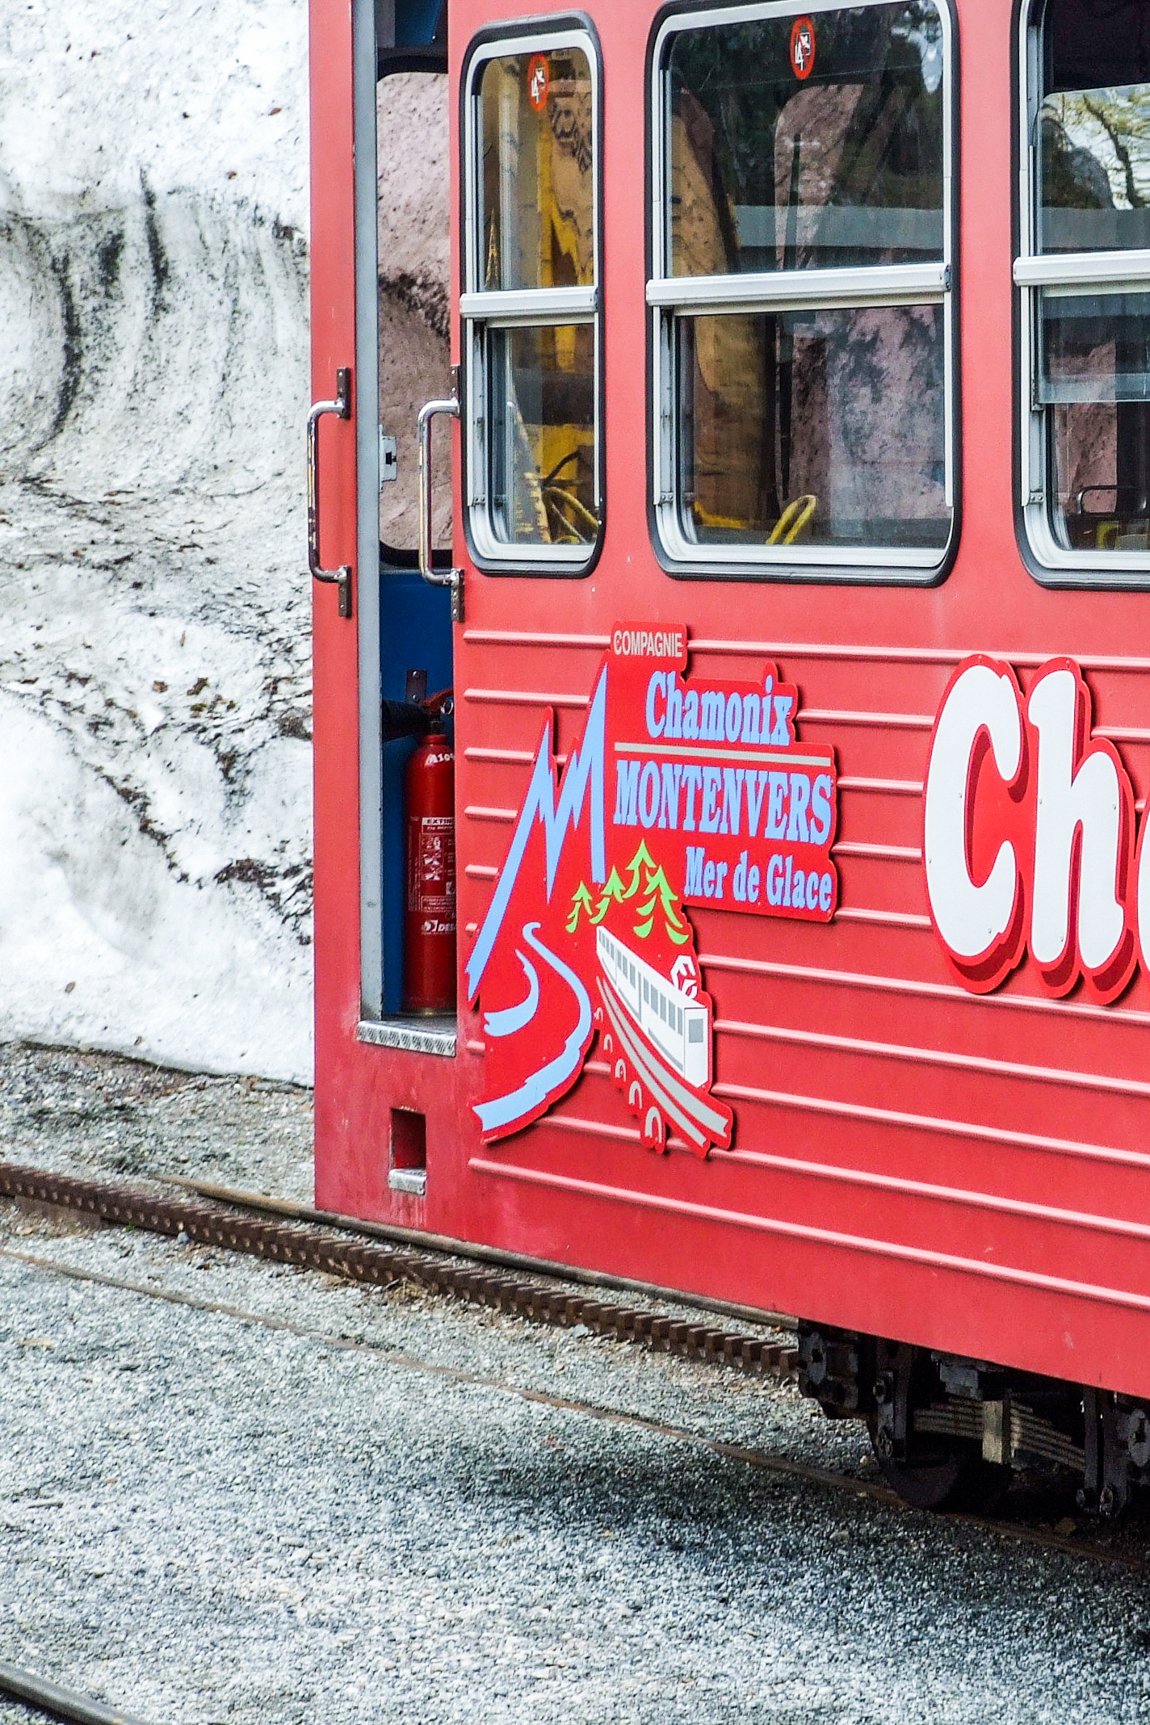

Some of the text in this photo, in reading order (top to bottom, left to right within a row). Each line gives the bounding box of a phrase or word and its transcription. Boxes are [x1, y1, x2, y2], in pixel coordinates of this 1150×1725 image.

[613, 630, 683, 658] COMPAGNIE
[645, 670, 793, 746] Chamonix
[613, 760, 833, 845] MONTENVERS
[684, 846, 832, 912] Mer de Glace
